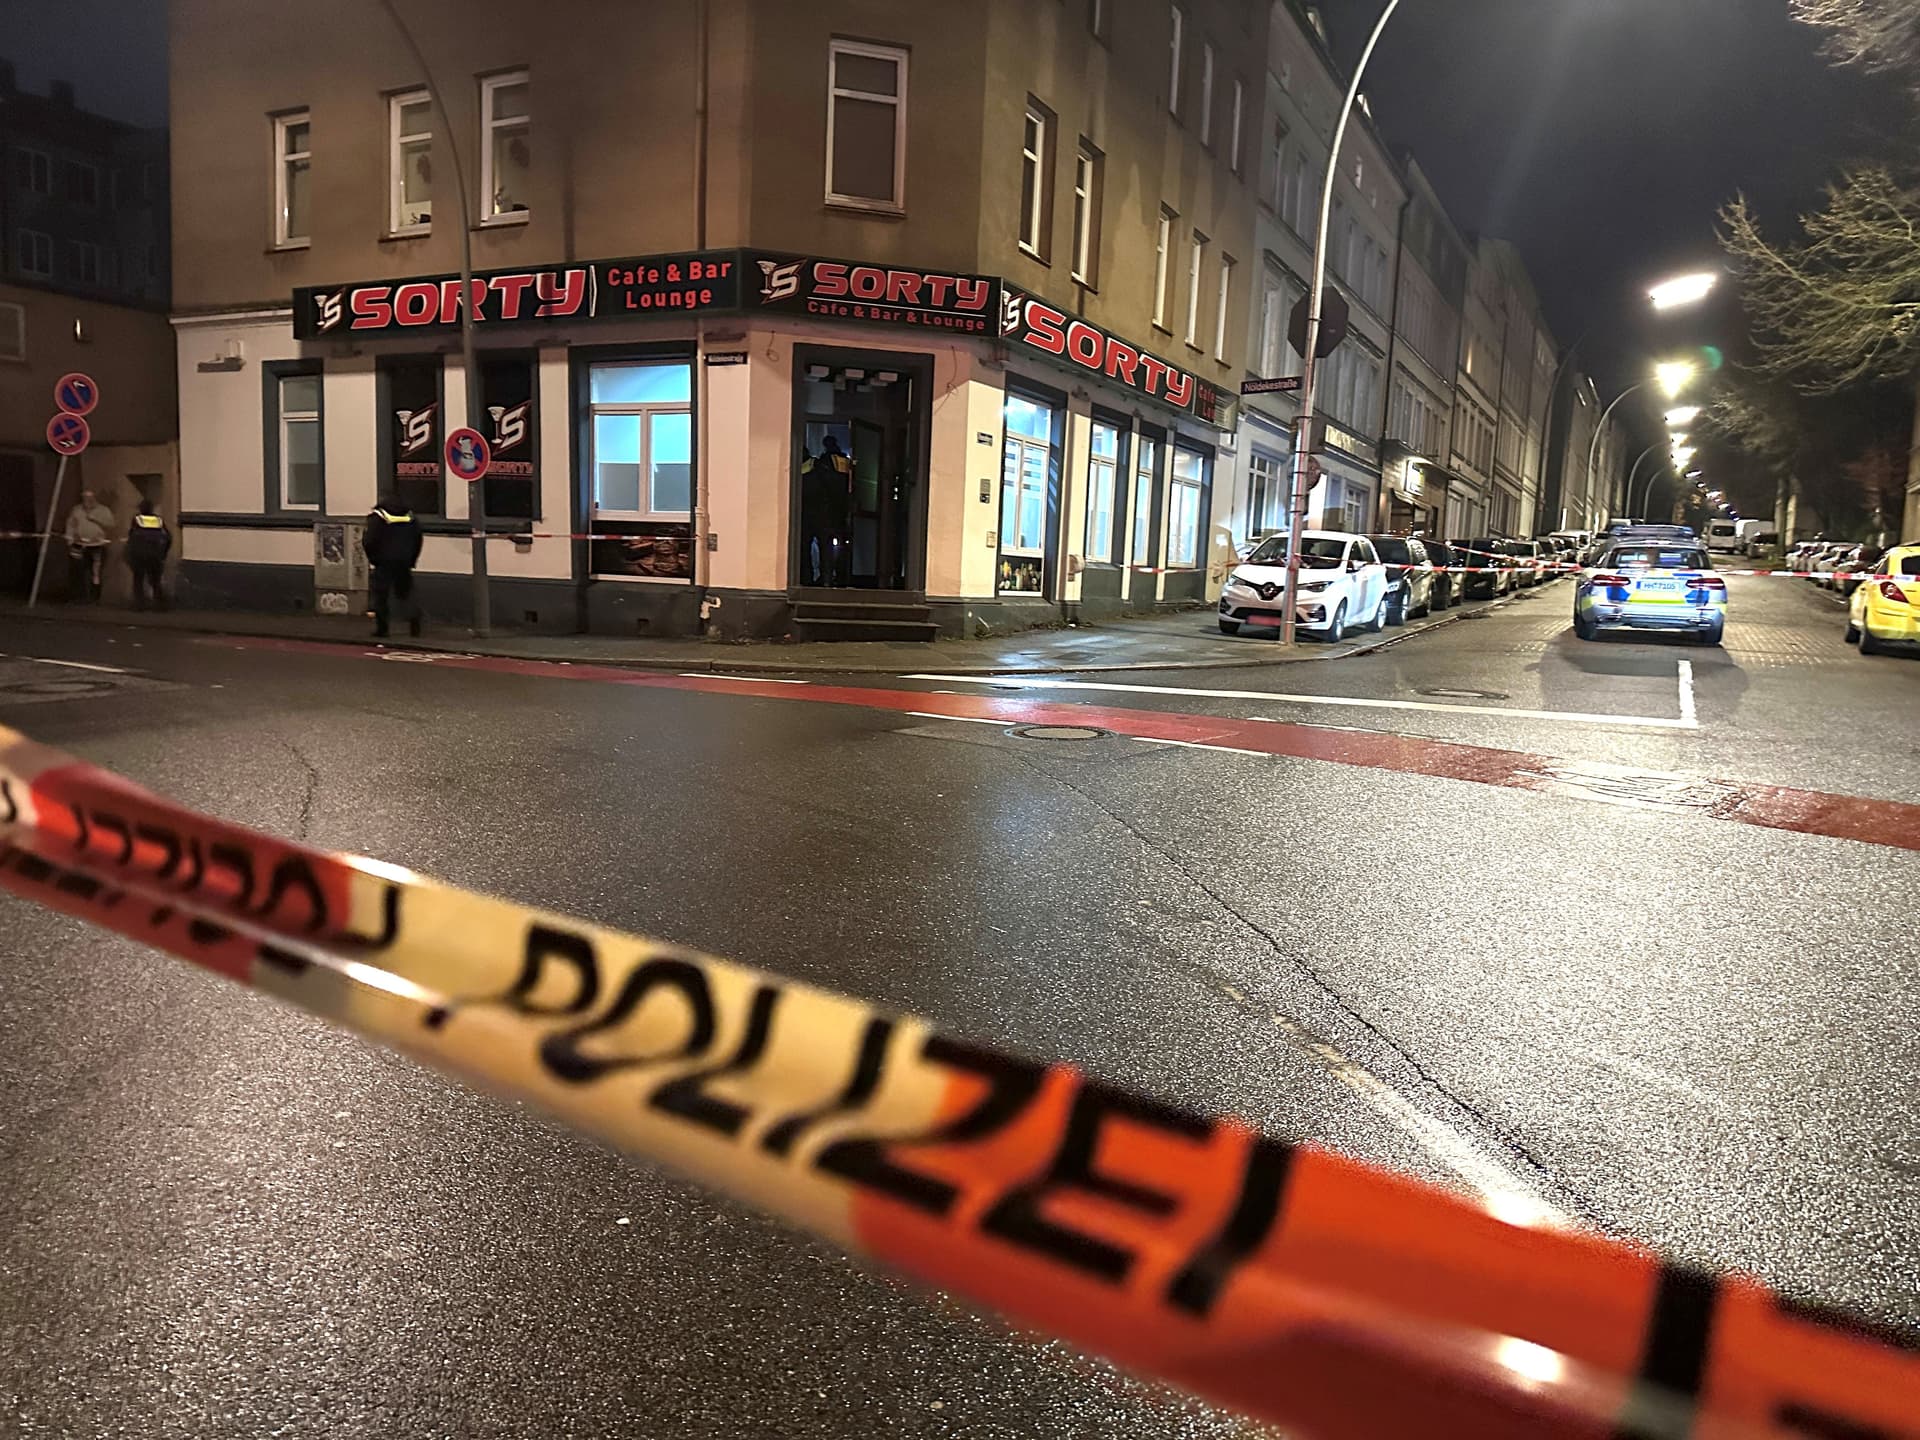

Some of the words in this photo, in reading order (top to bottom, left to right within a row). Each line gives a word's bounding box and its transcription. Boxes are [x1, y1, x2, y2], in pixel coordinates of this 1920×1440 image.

[607, 265, 658, 287] Cafe
[666, 264, 681, 283] &
[690, 260, 732, 281] Bar
[626, 287, 713, 309] Lounge
[812, 261, 990, 311] SORTY
[350, 268, 588, 330] SORTY
[807, 301, 848, 317] Cafe
[854, 306, 865, 318] &
[871, 307, 900, 321] Bar
[907, 312, 918, 323] &
[923, 313, 985, 331] Lounge
[1023, 300, 1194, 408] SORTY
[424, 920, 1298, 1318] POLIZEI
